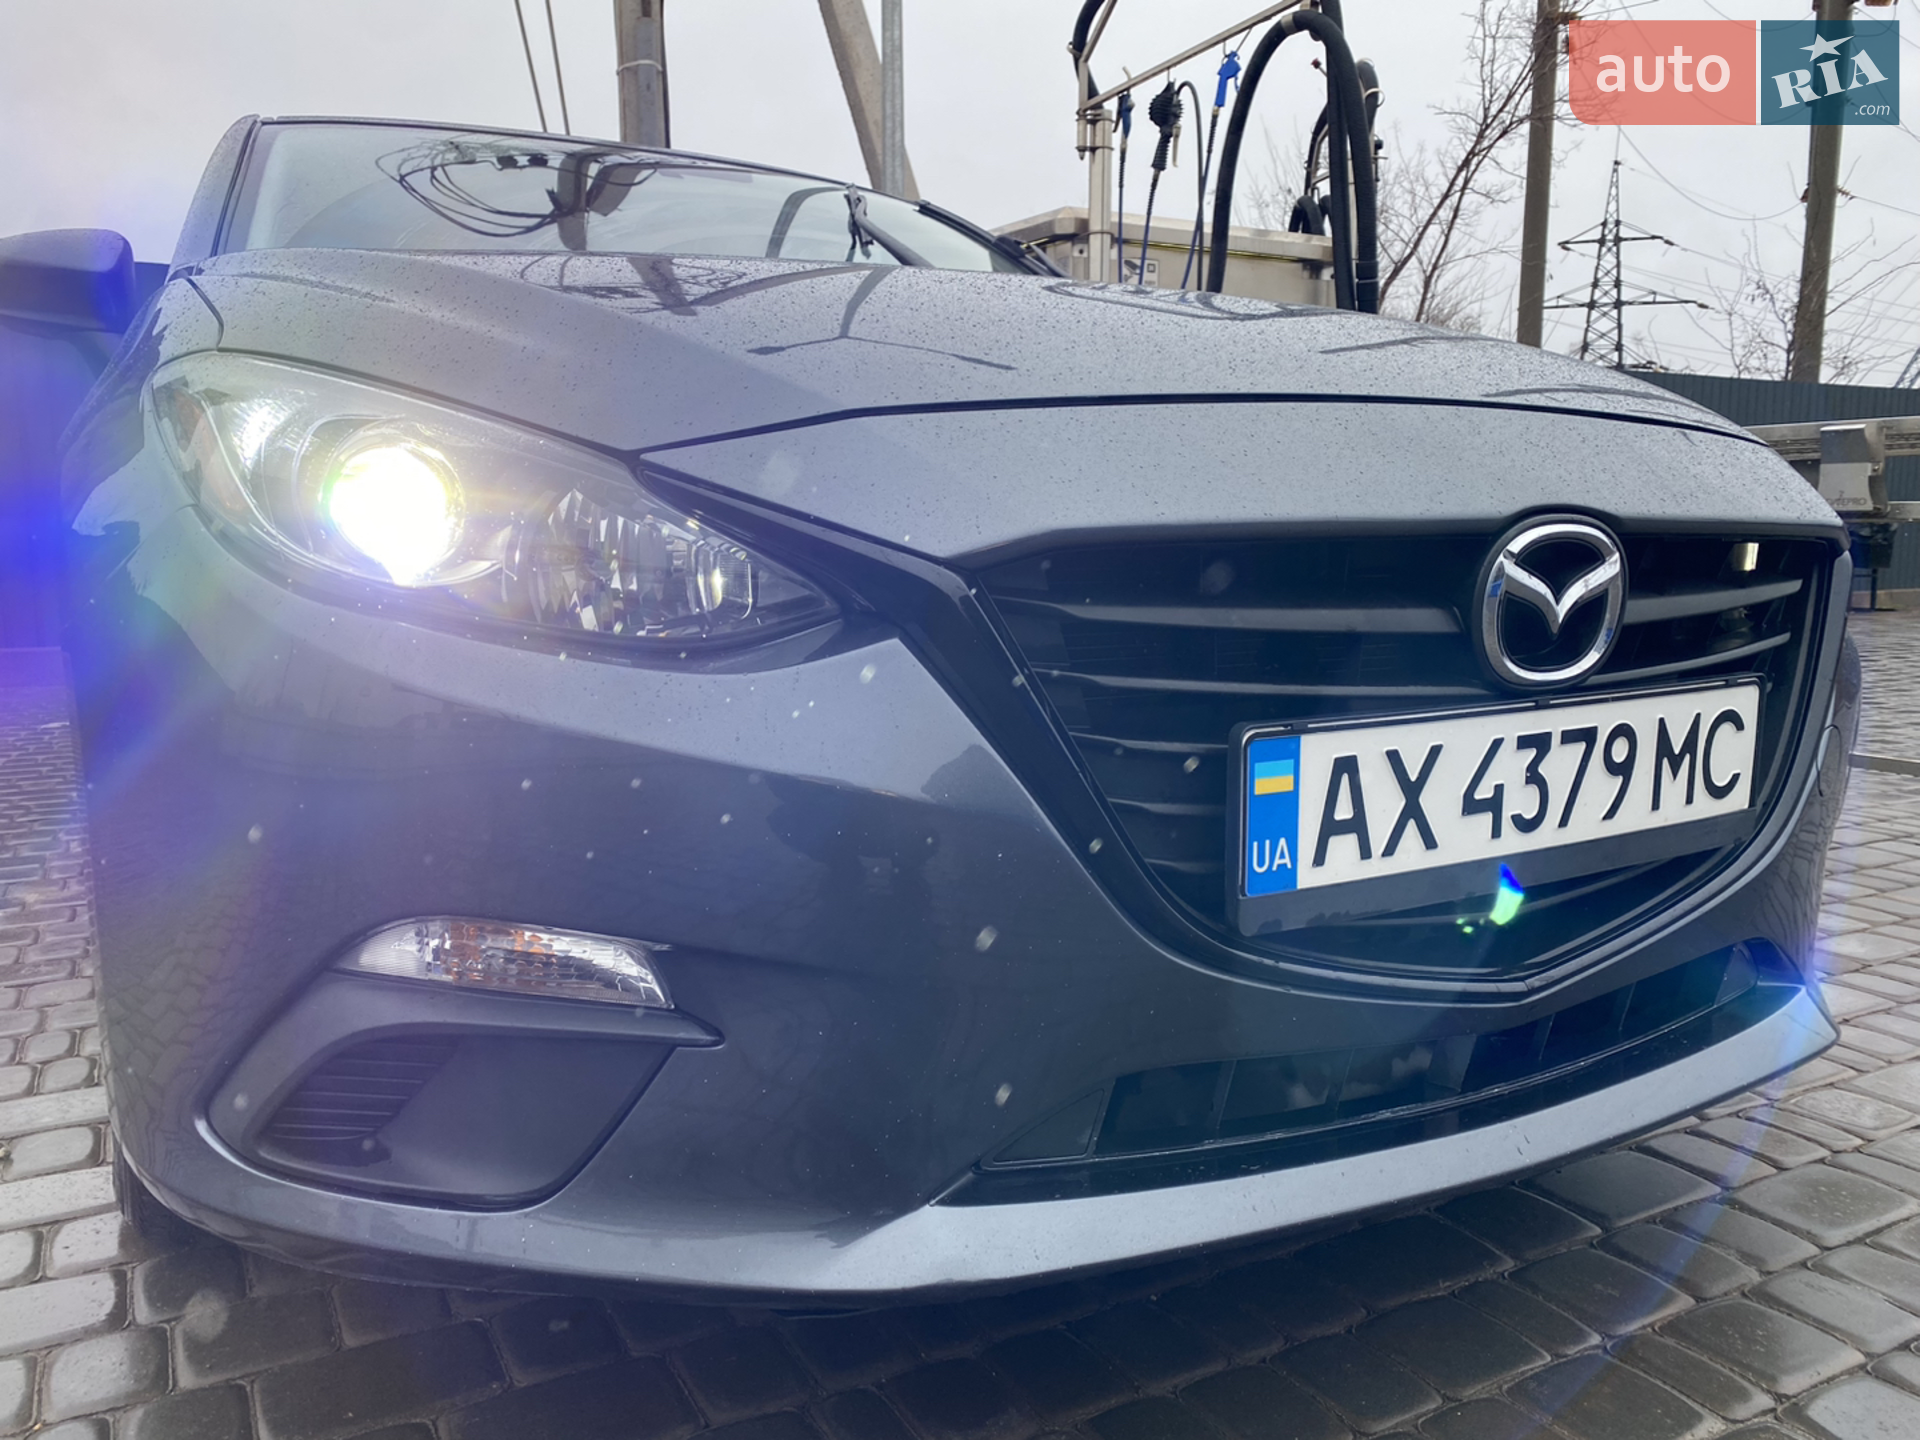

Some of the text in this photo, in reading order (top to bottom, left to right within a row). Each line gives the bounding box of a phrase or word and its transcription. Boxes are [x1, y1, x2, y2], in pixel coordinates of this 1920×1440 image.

[1310, 707, 1746, 868] AX 4379 MC
[1252, 837, 1292, 873] UA
